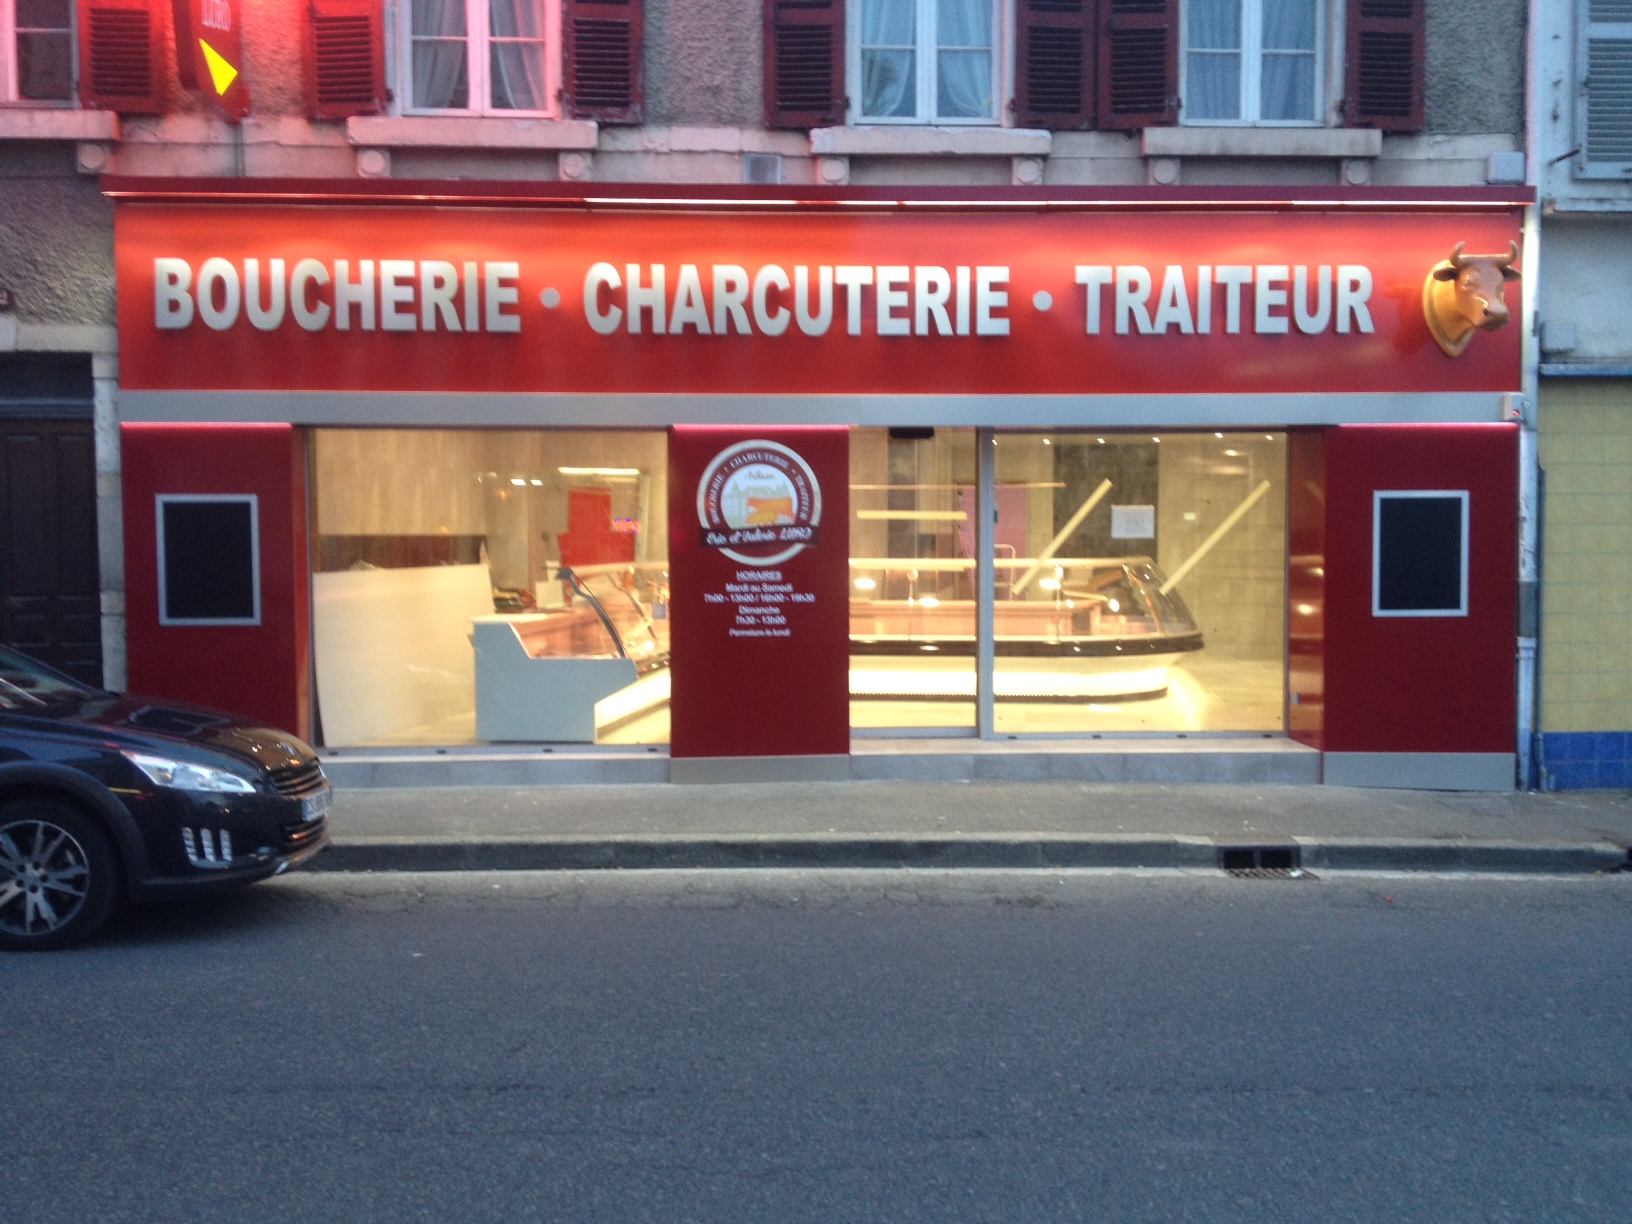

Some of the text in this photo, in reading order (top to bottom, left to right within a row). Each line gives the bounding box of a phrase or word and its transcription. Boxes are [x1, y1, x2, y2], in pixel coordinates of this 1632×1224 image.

[153, 256, 1375, 336] BOUCHERIE CHARCUTERIE TRAITEUR
[730, 452, 791, 470] CHARCUTERIE
[736, 570, 783, 582] HORAIRES
[725, 583, 794, 593] Mardi au Samedi
[703, 593, 725, 603] 7h00
[738, 605, 781, 615] Dimanche
